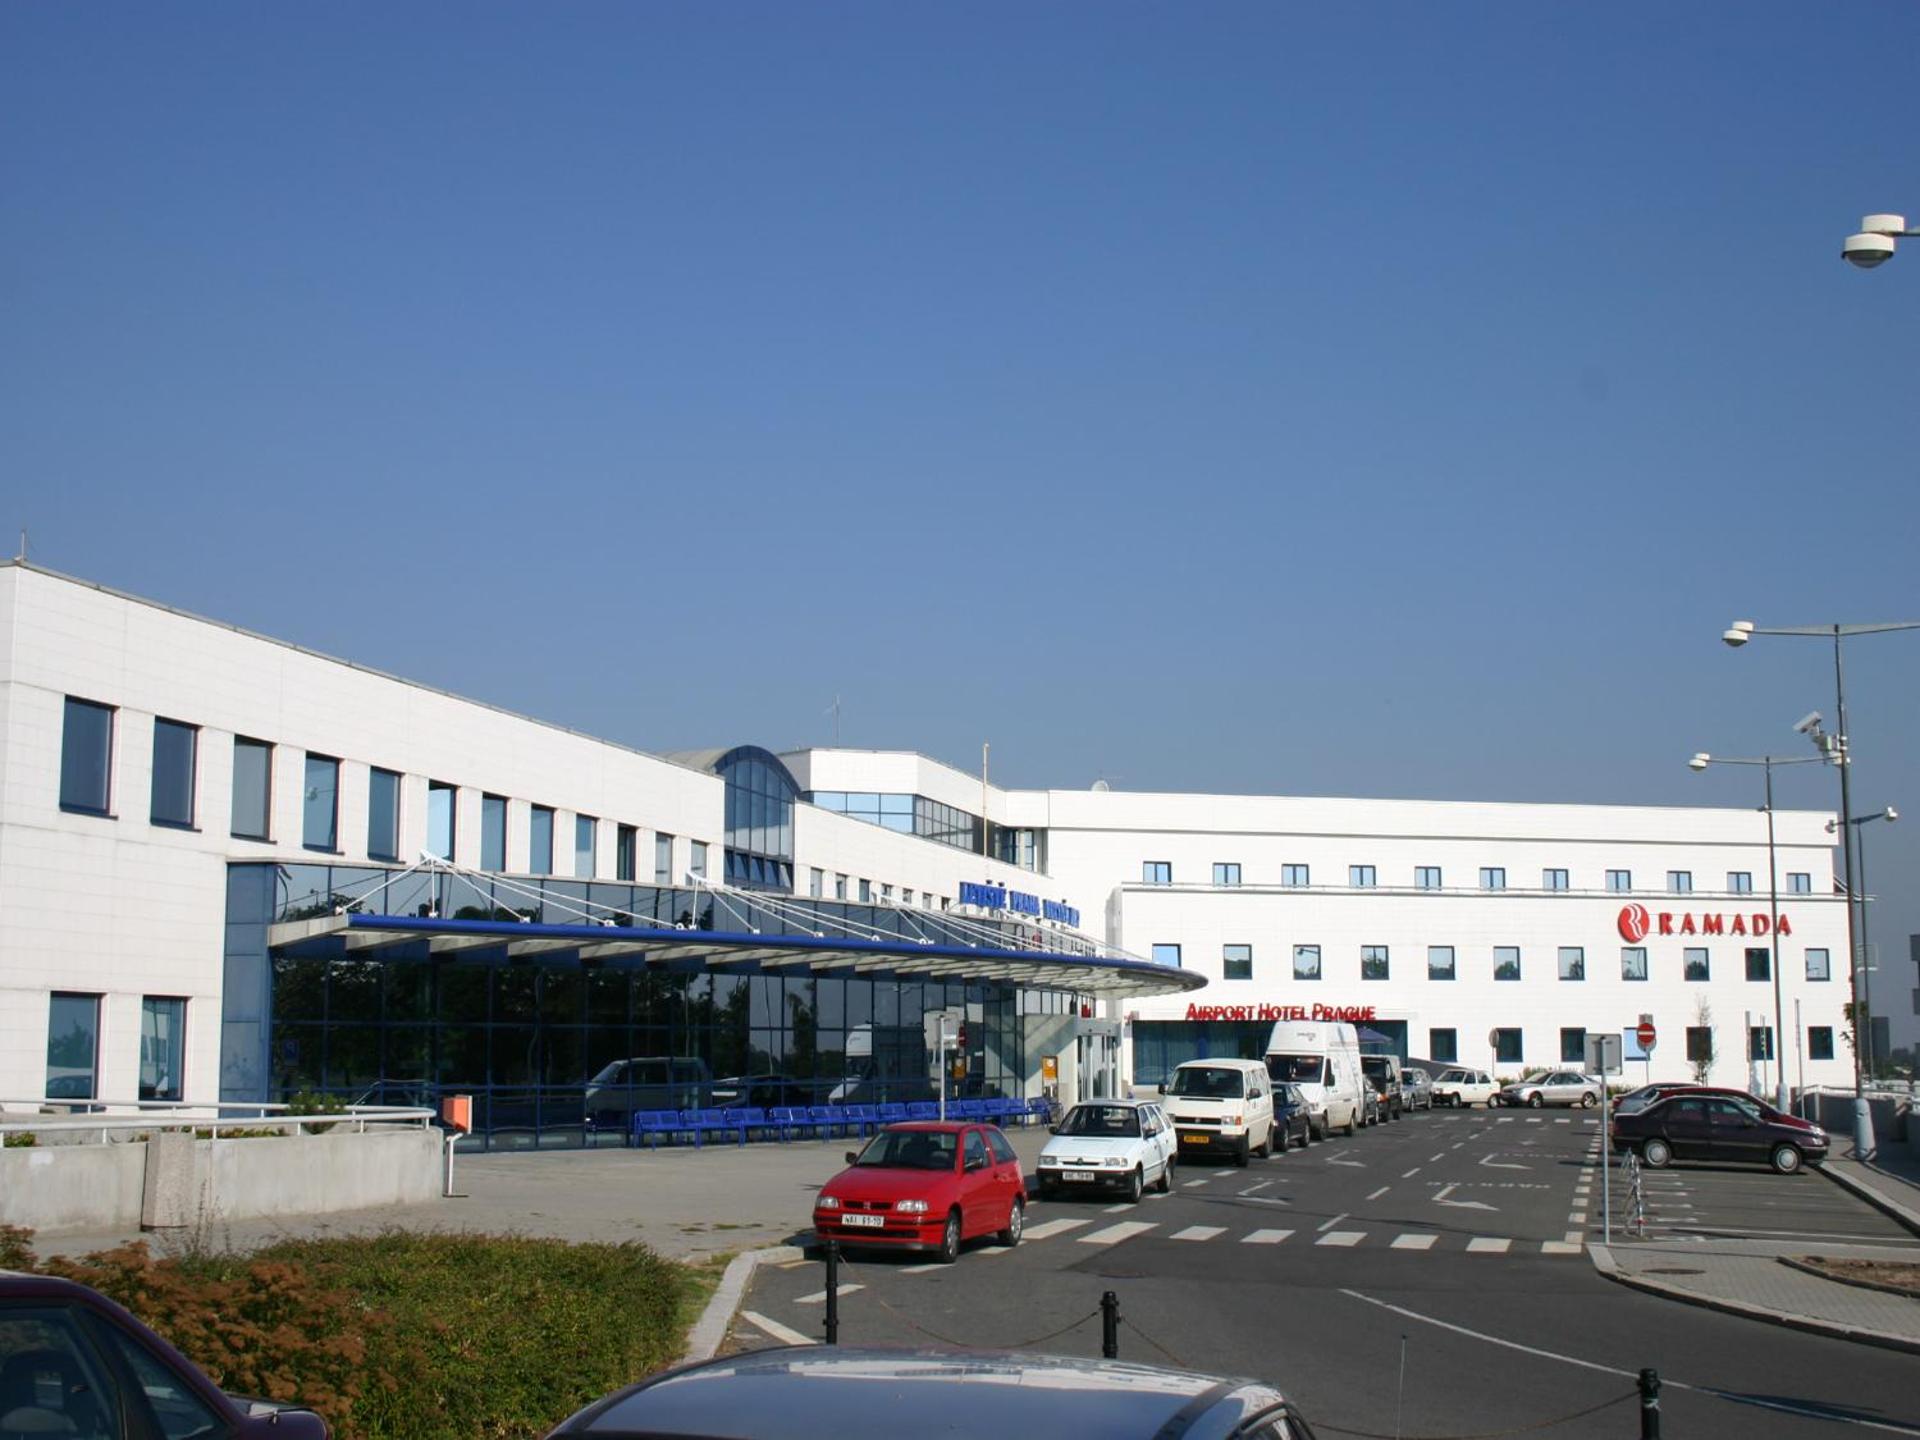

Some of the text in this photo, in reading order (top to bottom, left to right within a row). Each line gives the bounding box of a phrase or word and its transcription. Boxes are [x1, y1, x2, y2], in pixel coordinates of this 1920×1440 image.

[1658, 912, 1791, 937] RAMADA
[1185, 1003, 1376, 1021] AIRPORT HOTEL PRAGUE
